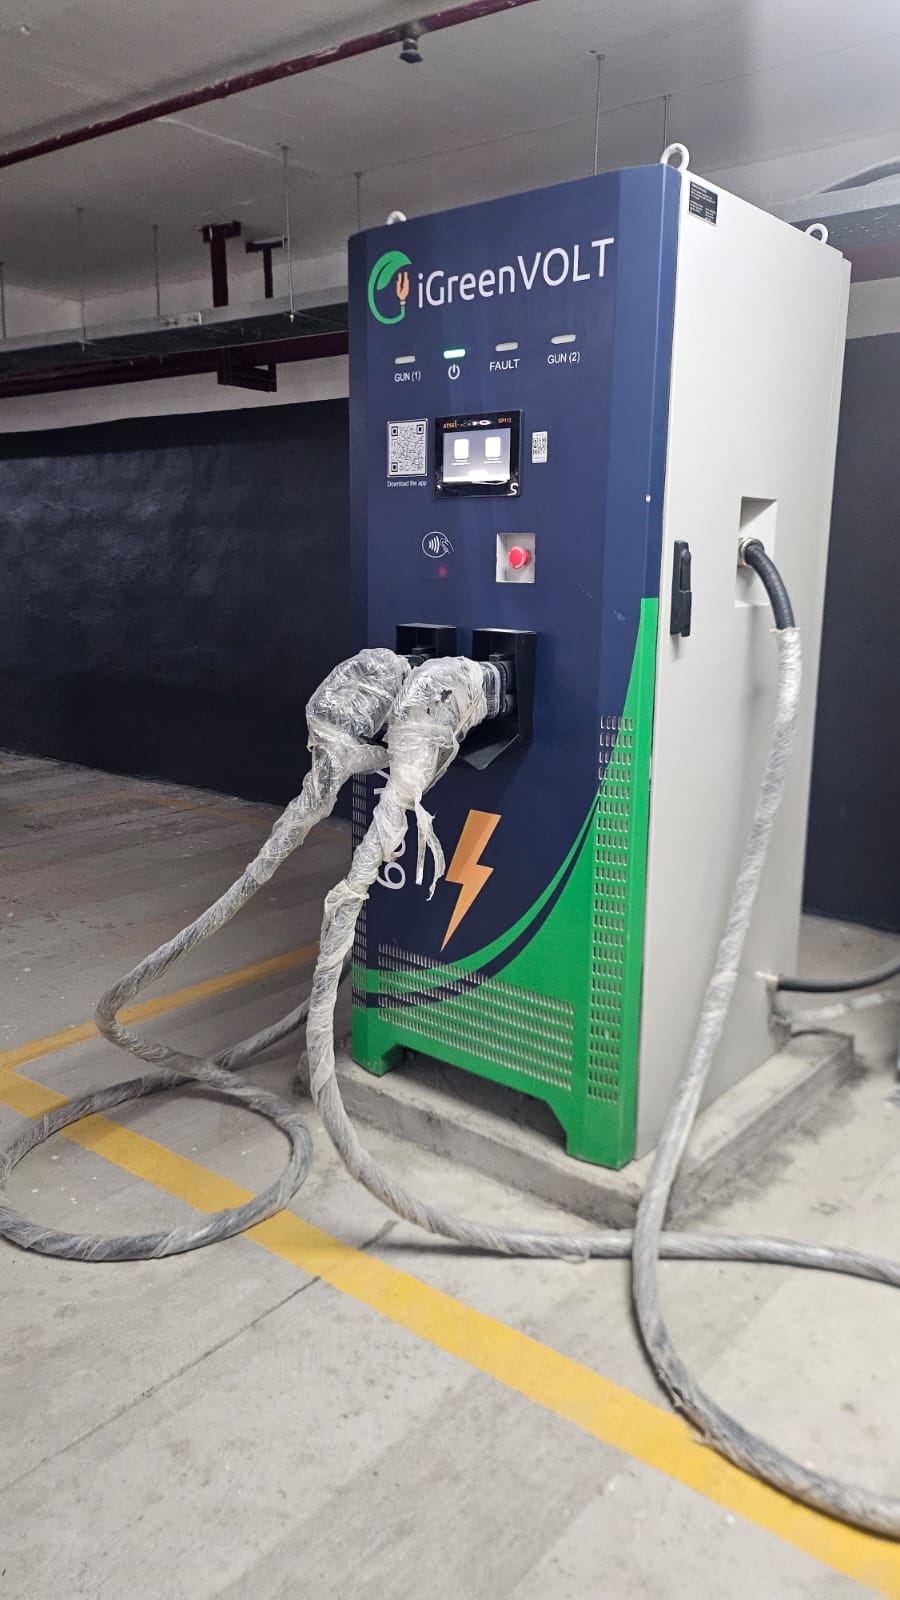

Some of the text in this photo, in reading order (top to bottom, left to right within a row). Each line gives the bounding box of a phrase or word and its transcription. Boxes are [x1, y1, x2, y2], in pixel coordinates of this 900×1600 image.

[418, 237, 615, 308] iGreenVOLT
[547, 352, 581, 365] GUN (2)
[489, 359, 520, 372] FAULT
[394, 371, 421, 382] GUN (1)
